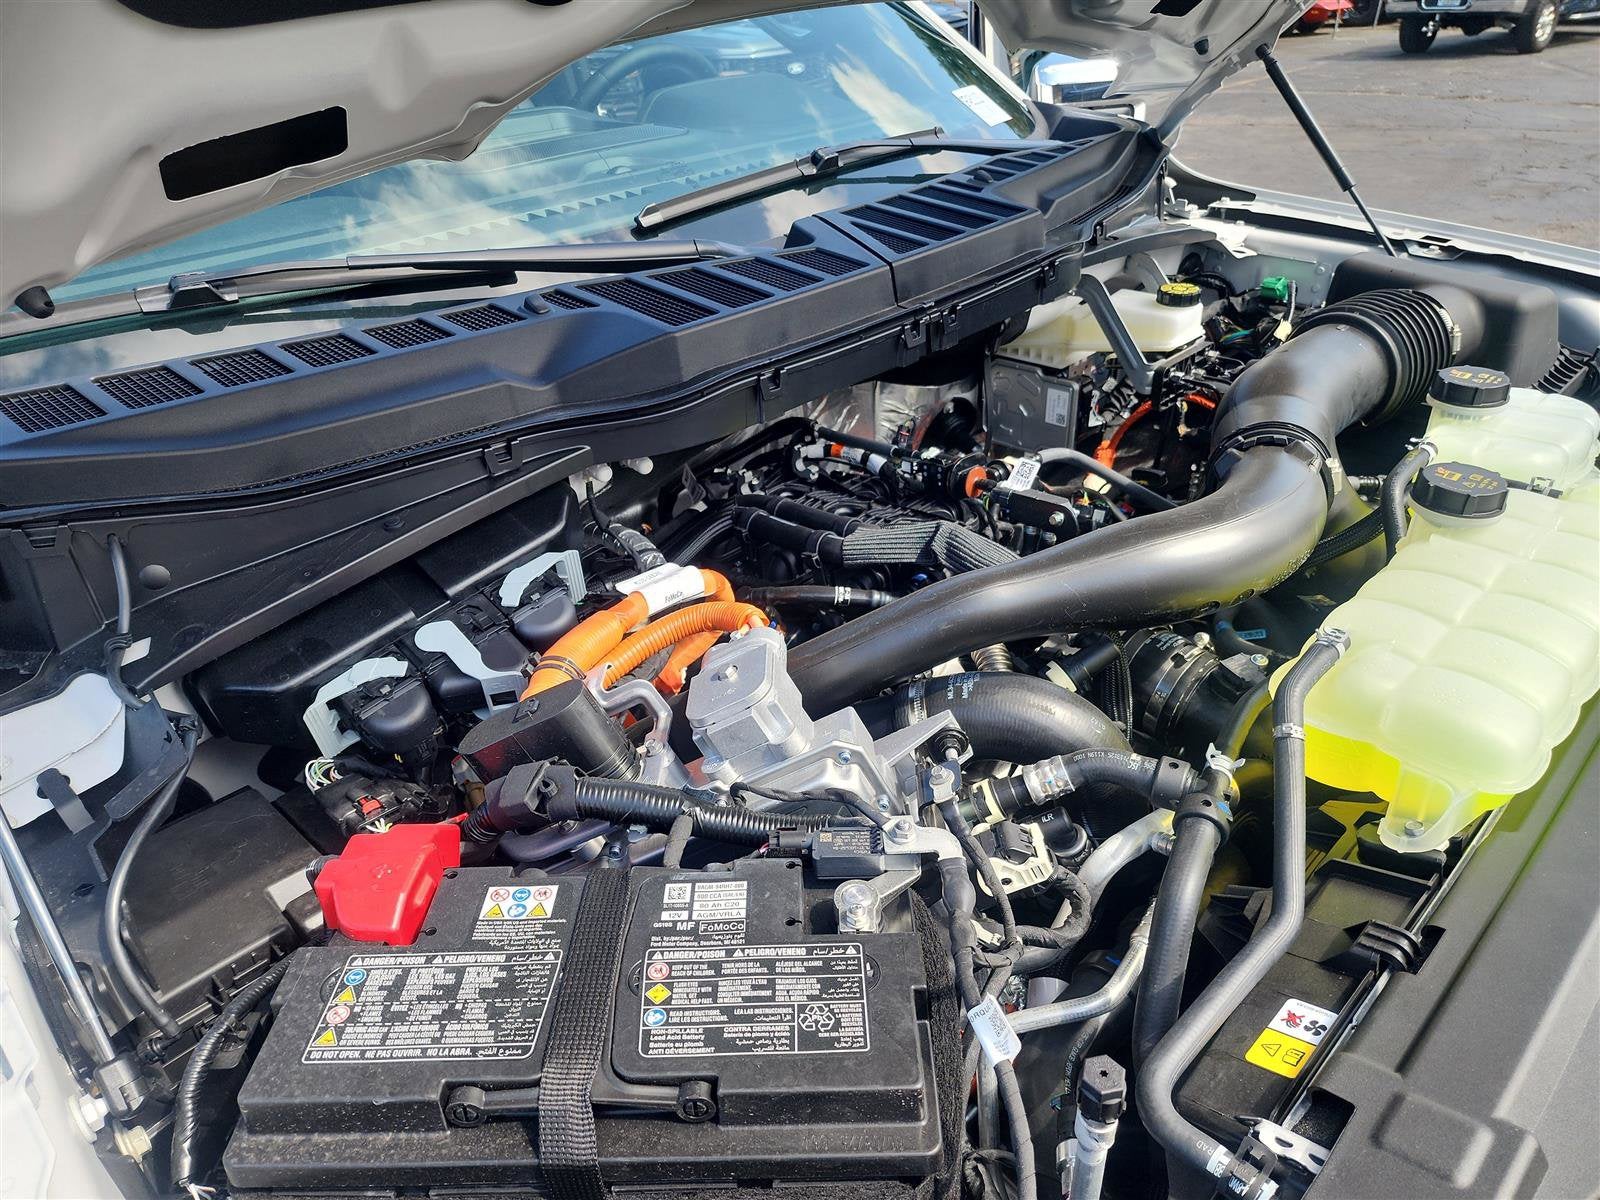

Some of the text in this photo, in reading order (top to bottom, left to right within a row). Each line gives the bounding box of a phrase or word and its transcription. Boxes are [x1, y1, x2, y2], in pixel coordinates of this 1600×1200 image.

[696, 911, 742, 919] AGM/VRLA
[677, 921, 695, 930] MF
[701, 922, 744, 931] FoMoCo
[663, 947, 806, 959] DANGER/POISON PELIGRO/VENENO
[363, 954, 506, 966] DANGER/POISON PELIGRO/VENENO
[339, 1050, 361, 1058] OPEN.
[392, 1049, 422, 1057] OUVRIR.
[438, 1048, 449, 1056] LA
[449, 1047, 472, 1056] ABRA.
